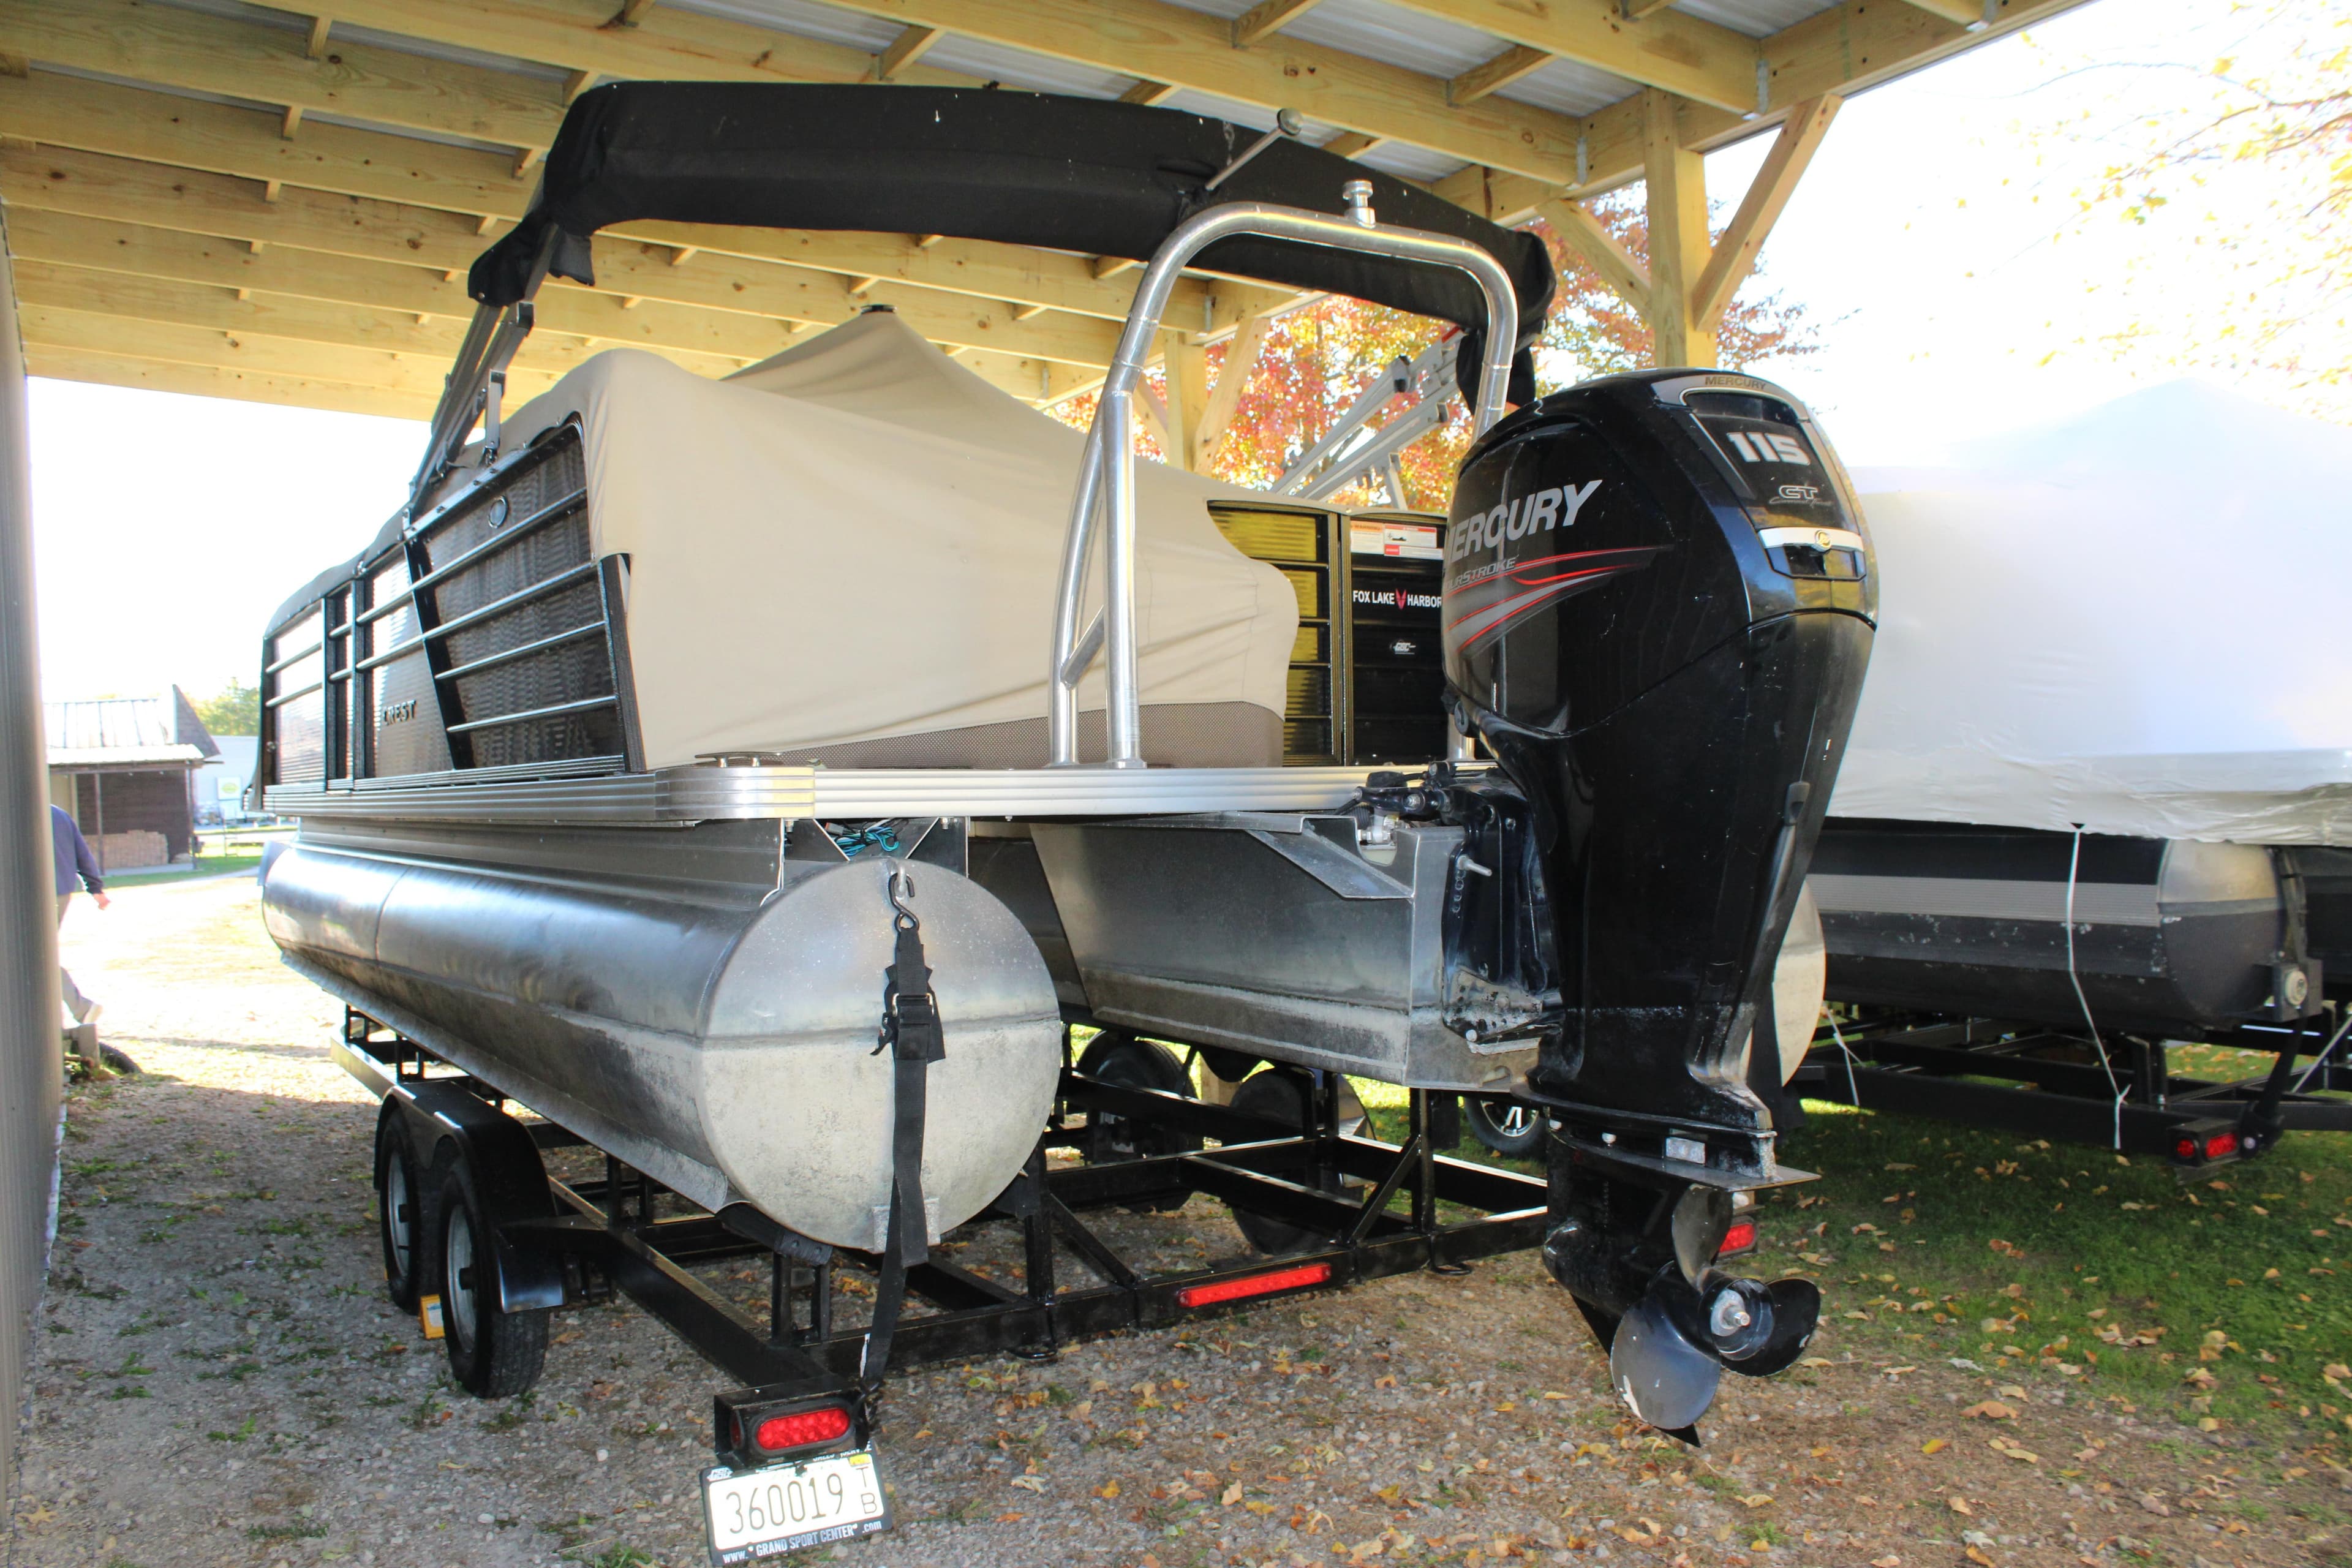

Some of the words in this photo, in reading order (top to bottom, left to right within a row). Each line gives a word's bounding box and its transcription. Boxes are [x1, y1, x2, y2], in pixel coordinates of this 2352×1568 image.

[1705, 376, 1766, 390] MERCURY
[1726, 431, 1811, 466] 115
[1778, 485, 1818, 500] GT
[1352, 590, 1371, 603] FOX
[1371, 591, 1395, 605] LAKE
[382, 699, 417, 726] CREST
[726, 1473, 843, 1534] 360019
[756, 1539, 788, 1557] GRAND
[789, 1531, 819, 1550] SPORT
[820, 1526, 855, 1542] CENTER
[862, 1520, 882, 1534] .com
